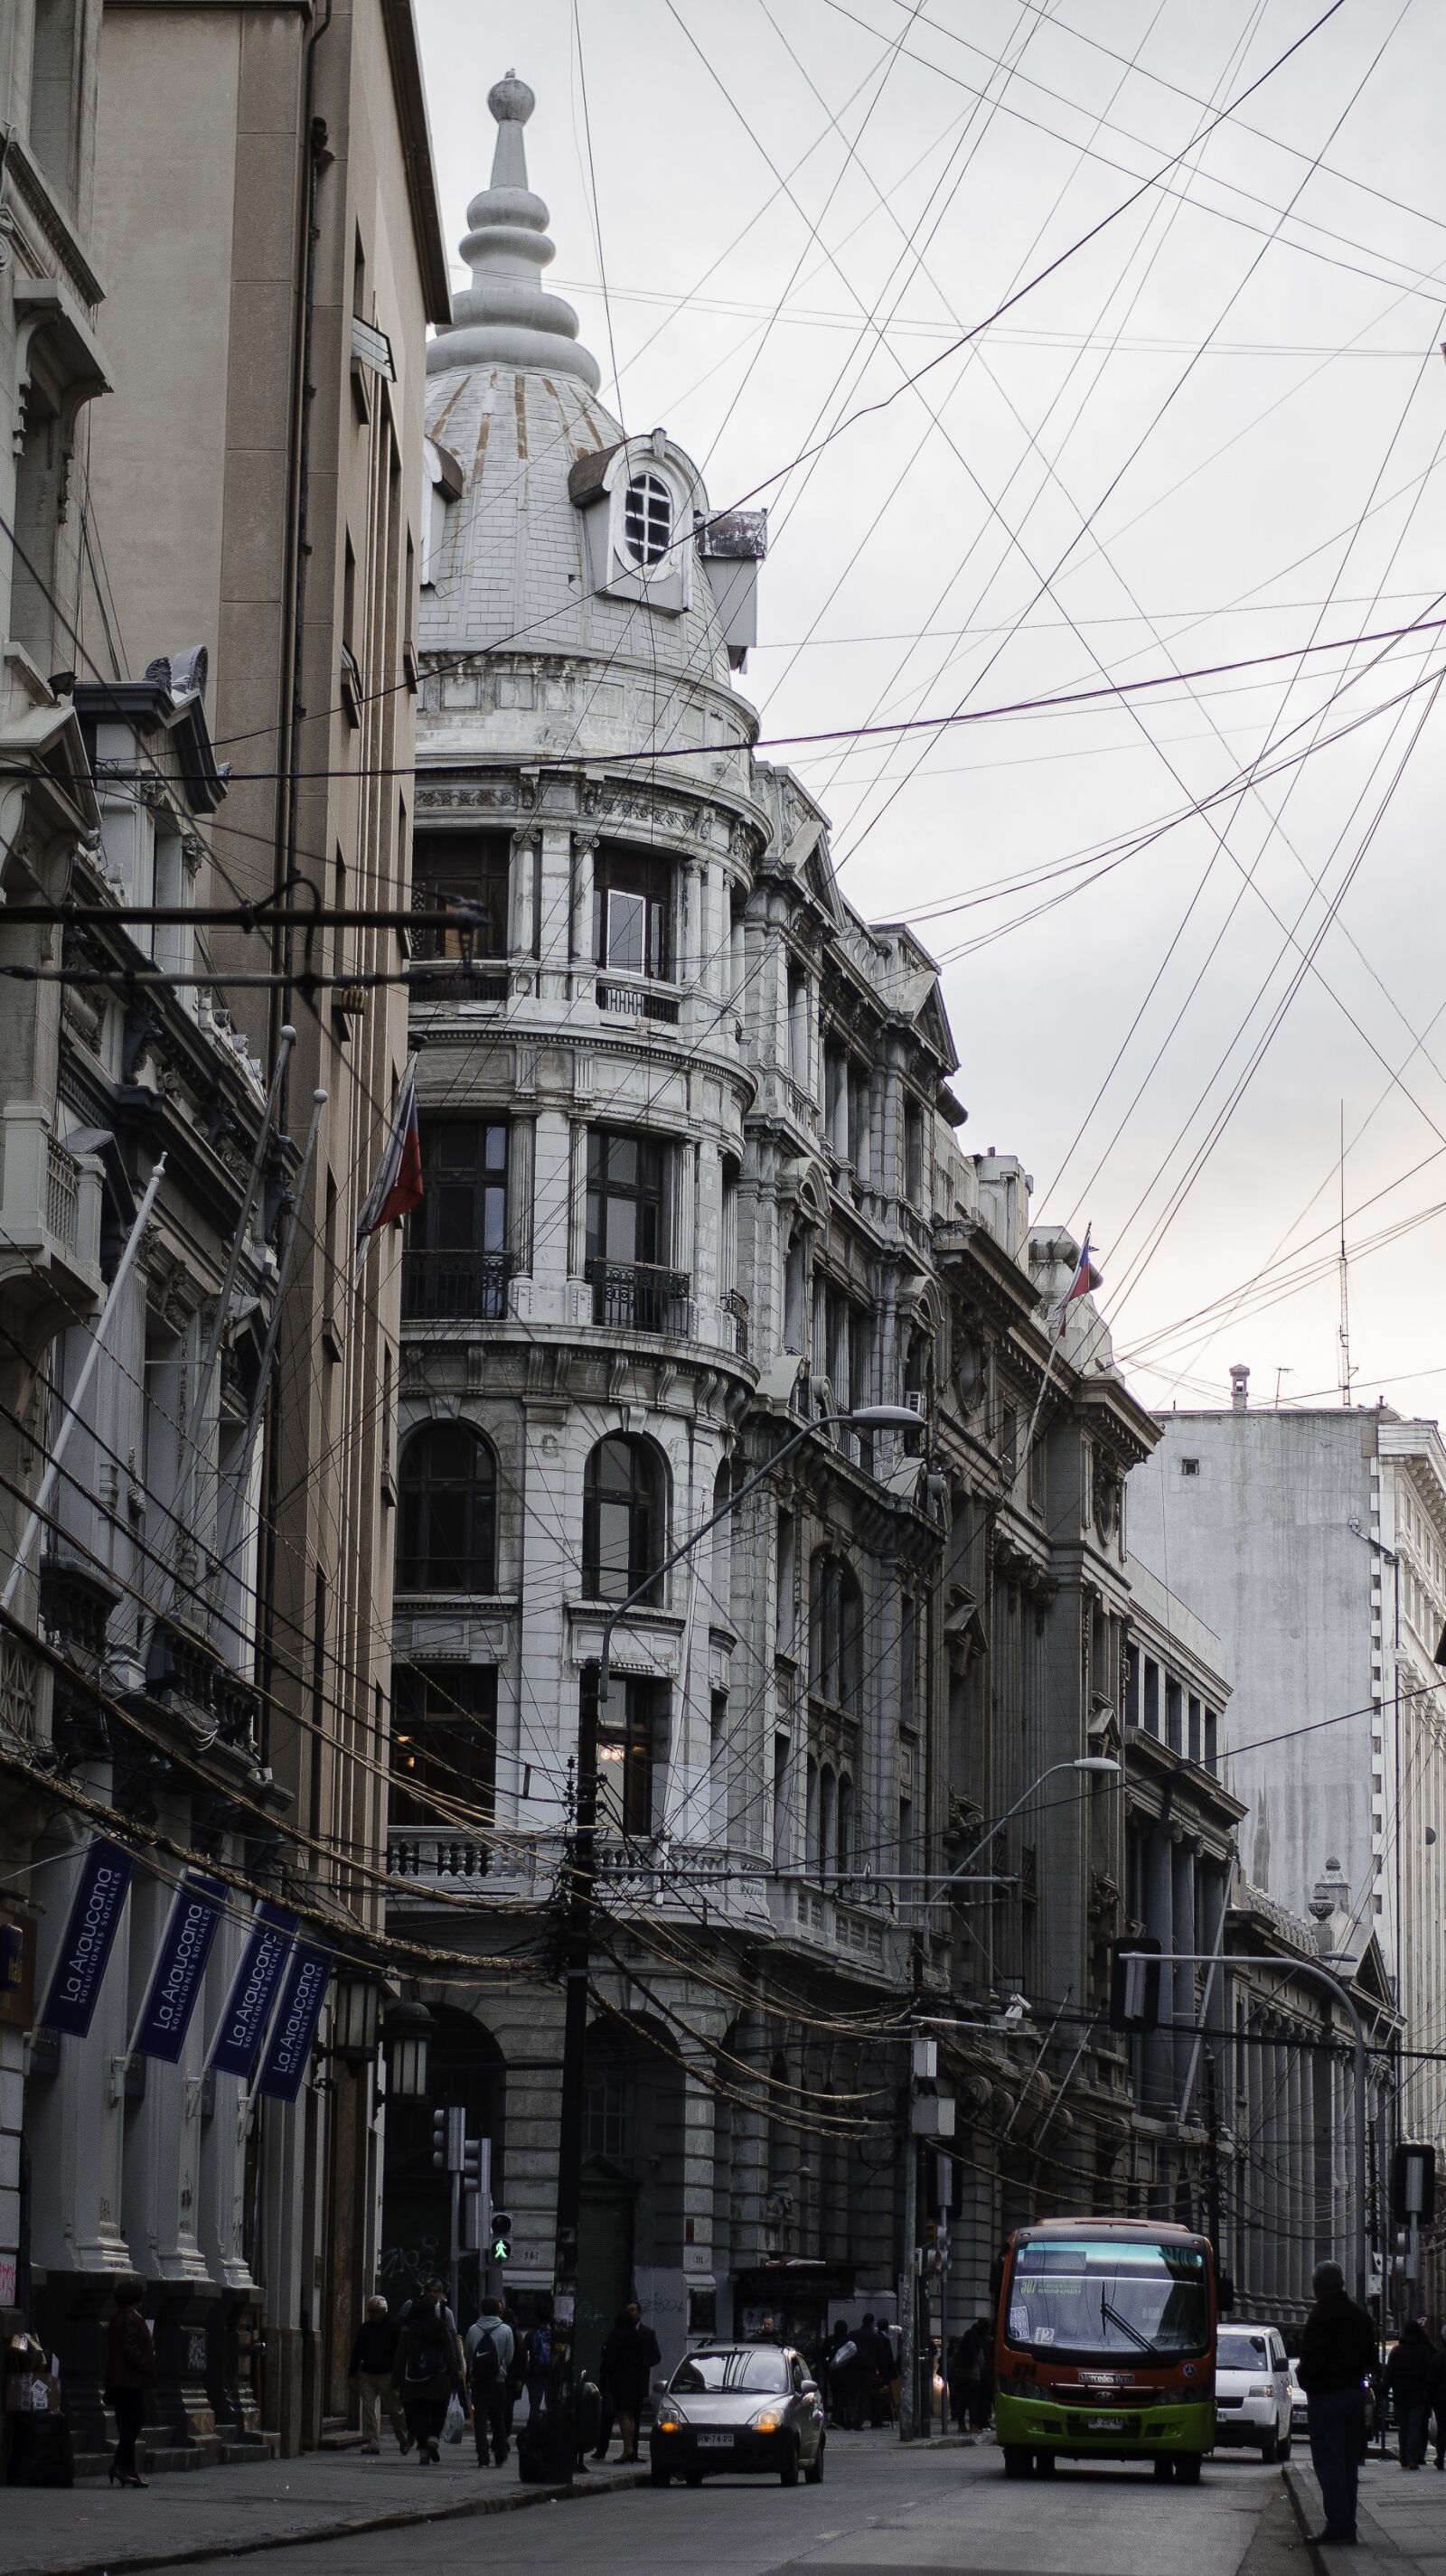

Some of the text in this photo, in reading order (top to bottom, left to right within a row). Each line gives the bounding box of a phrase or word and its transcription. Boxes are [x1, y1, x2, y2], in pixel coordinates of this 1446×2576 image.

[60, 1867, 113, 2003] La Araucana
[79, 1871, 122, 2004] SOLUCIONES SOCIALES
[152, 1904, 203, 2030] La Araucana
[171, 1908, 212, 2031] SOLUCIONES SOCIALES
[226, 2024, 247, 2047] La
[243, 1936, 285, 2049] SOLUCIONES SOCIALE
[272, 1962, 316, 2074] La Araucana
[288, 1965, 324, 2075] SOLUCIONES SOCIALES
[1036, 2328, 1054, 2343] 12
[1080, 2374, 1133, 2384] Mercedes-Benz
